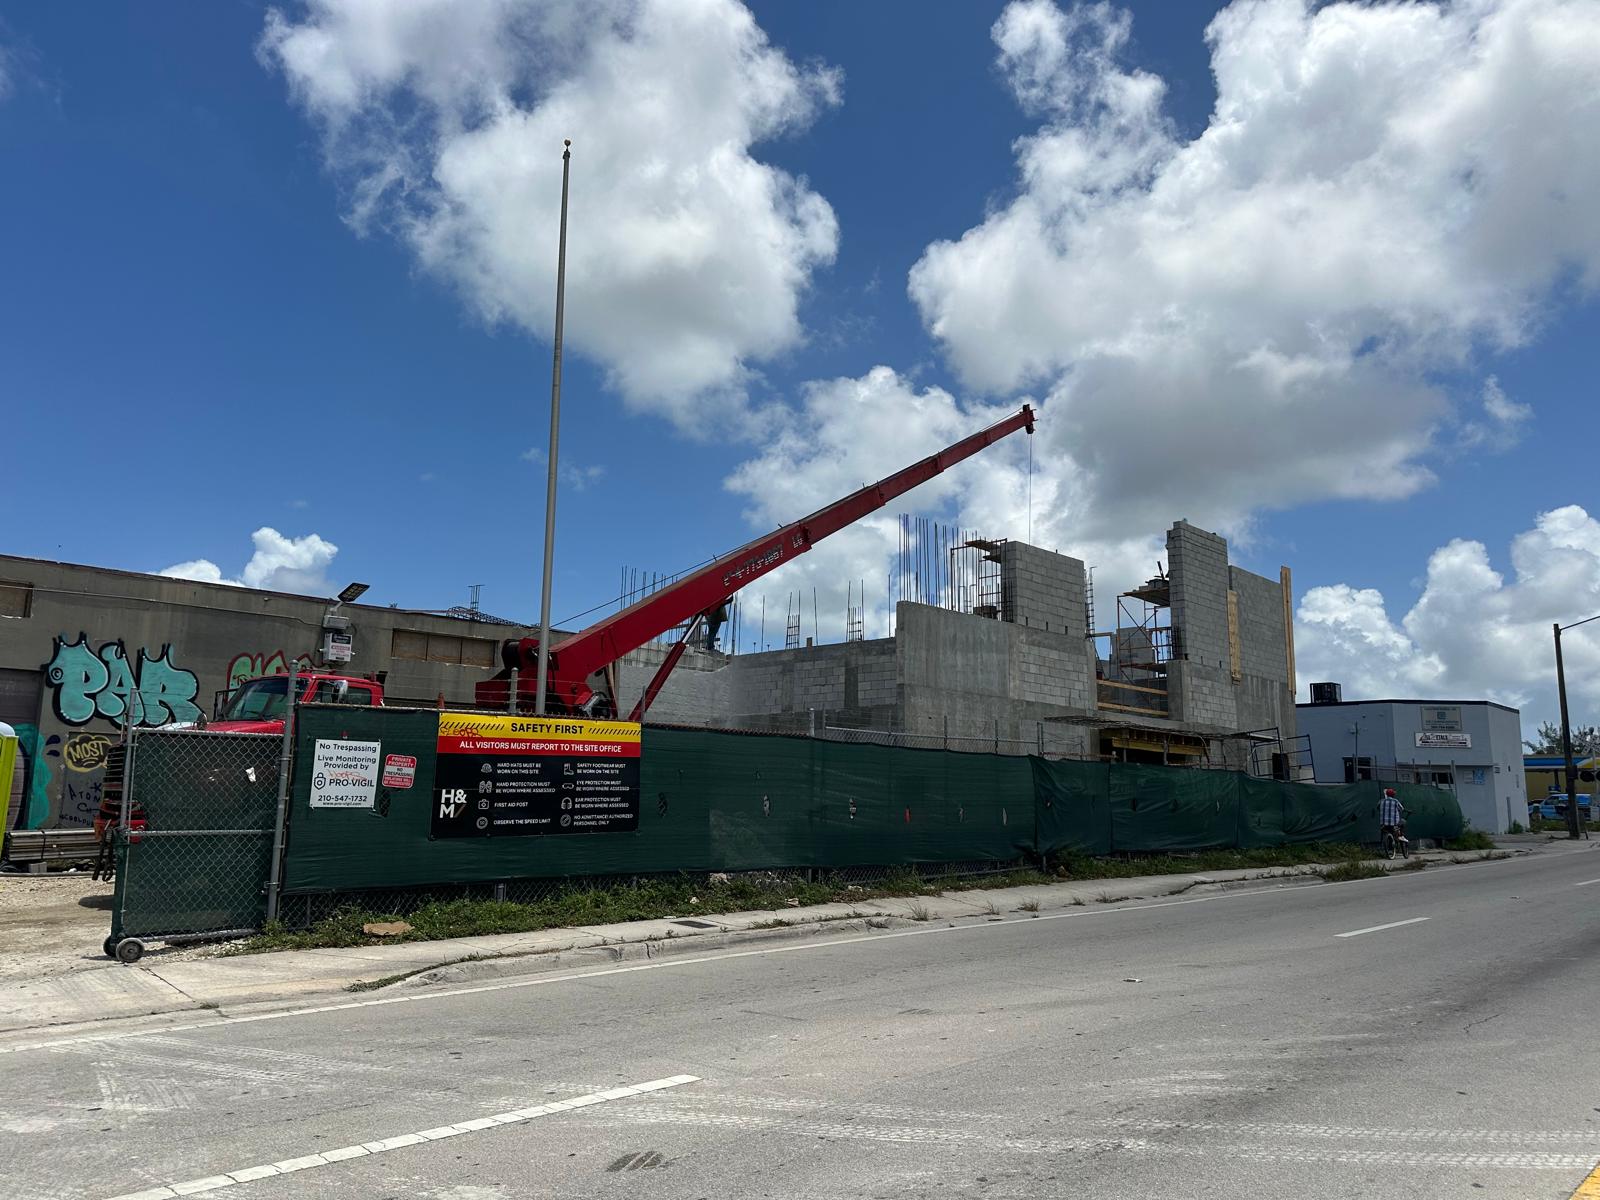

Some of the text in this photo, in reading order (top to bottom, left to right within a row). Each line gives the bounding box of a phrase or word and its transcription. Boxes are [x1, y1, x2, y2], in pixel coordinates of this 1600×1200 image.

[511, 723, 584, 734] SAFETY FIRST
[69, 741, 107, 762] MOST
[333, 744, 377, 753] Trespassing
[476, 741, 509, 749] VISITORS
[510, 742, 530, 750] MUST
[532, 743, 559, 751] REPORT
[571, 744, 583, 752] THE
[585, 744, 598, 752] SITE
[336, 756, 376, 764] Monitoring
[329, 779, 374, 787] PRO-VIGIL
[441, 789, 467, 803] H&
